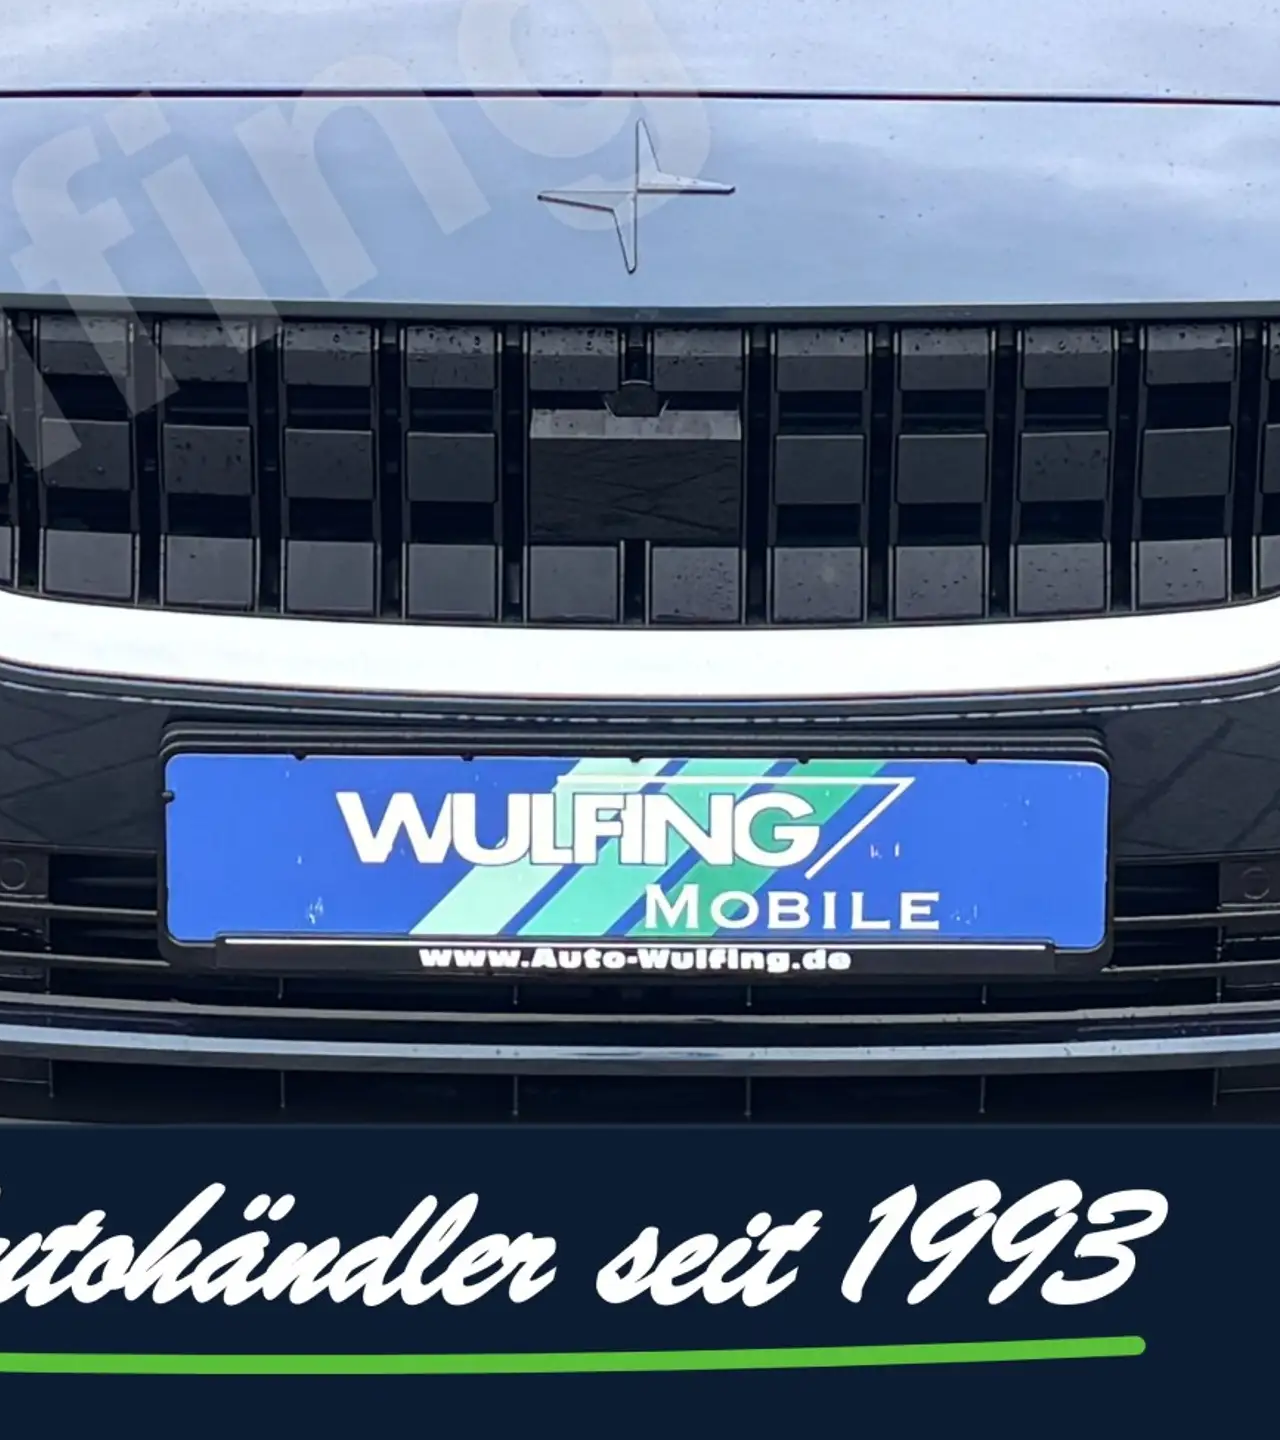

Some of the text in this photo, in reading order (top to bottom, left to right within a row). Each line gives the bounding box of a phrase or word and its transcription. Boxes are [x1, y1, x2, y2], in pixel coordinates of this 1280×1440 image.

[335, 791, 821, 866] WULFING
[644, 883, 940, 930] MOBILE
[419, 947, 852, 973] www.Auto-Wulfing.de
